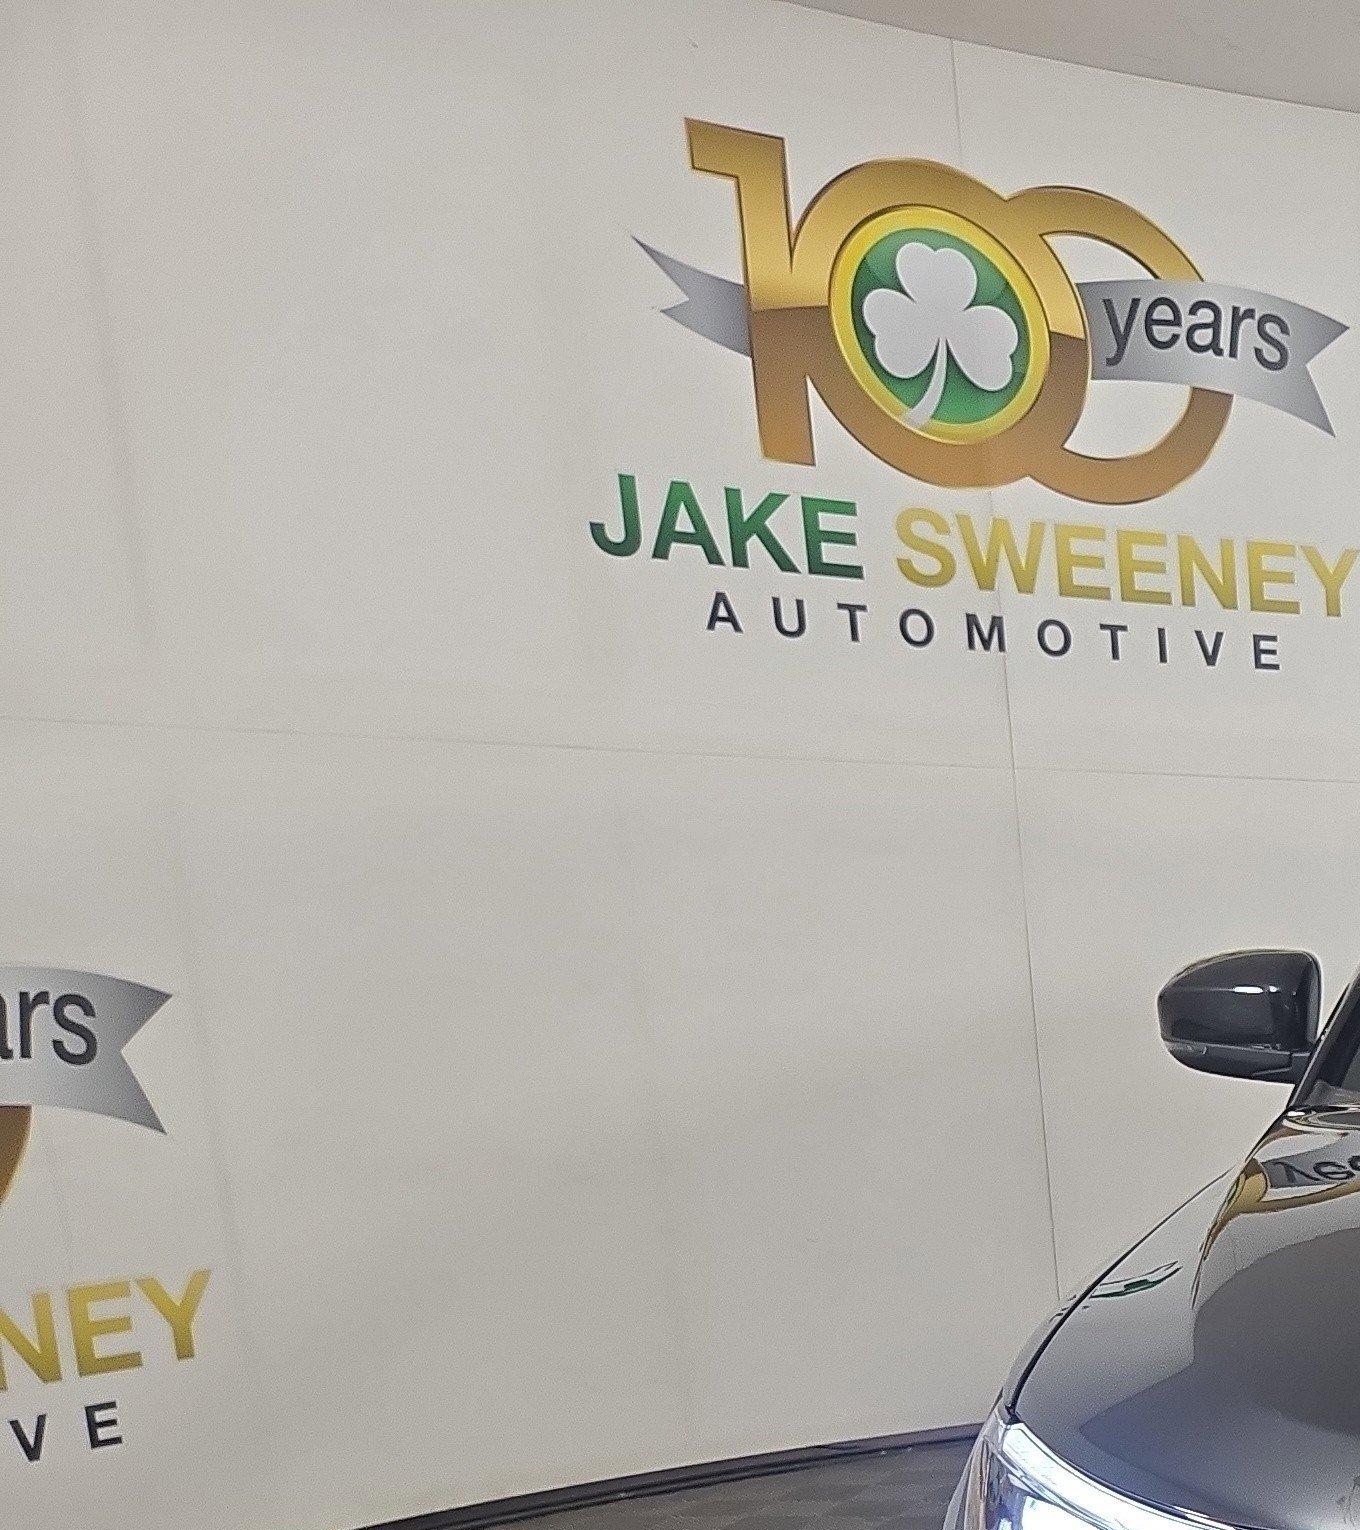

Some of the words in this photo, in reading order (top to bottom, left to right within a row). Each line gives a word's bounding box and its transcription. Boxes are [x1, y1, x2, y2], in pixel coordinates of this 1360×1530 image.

[685, 118, 1234, 505] 100
[1101, 293, 1291, 372] years
[589, 473, 866, 580] JAKE
[706, 592, 1281, 671] AUTOMOTIVE
[0, 988, 99, 1067] rs
[9, 1400, 124, 1463] VE
